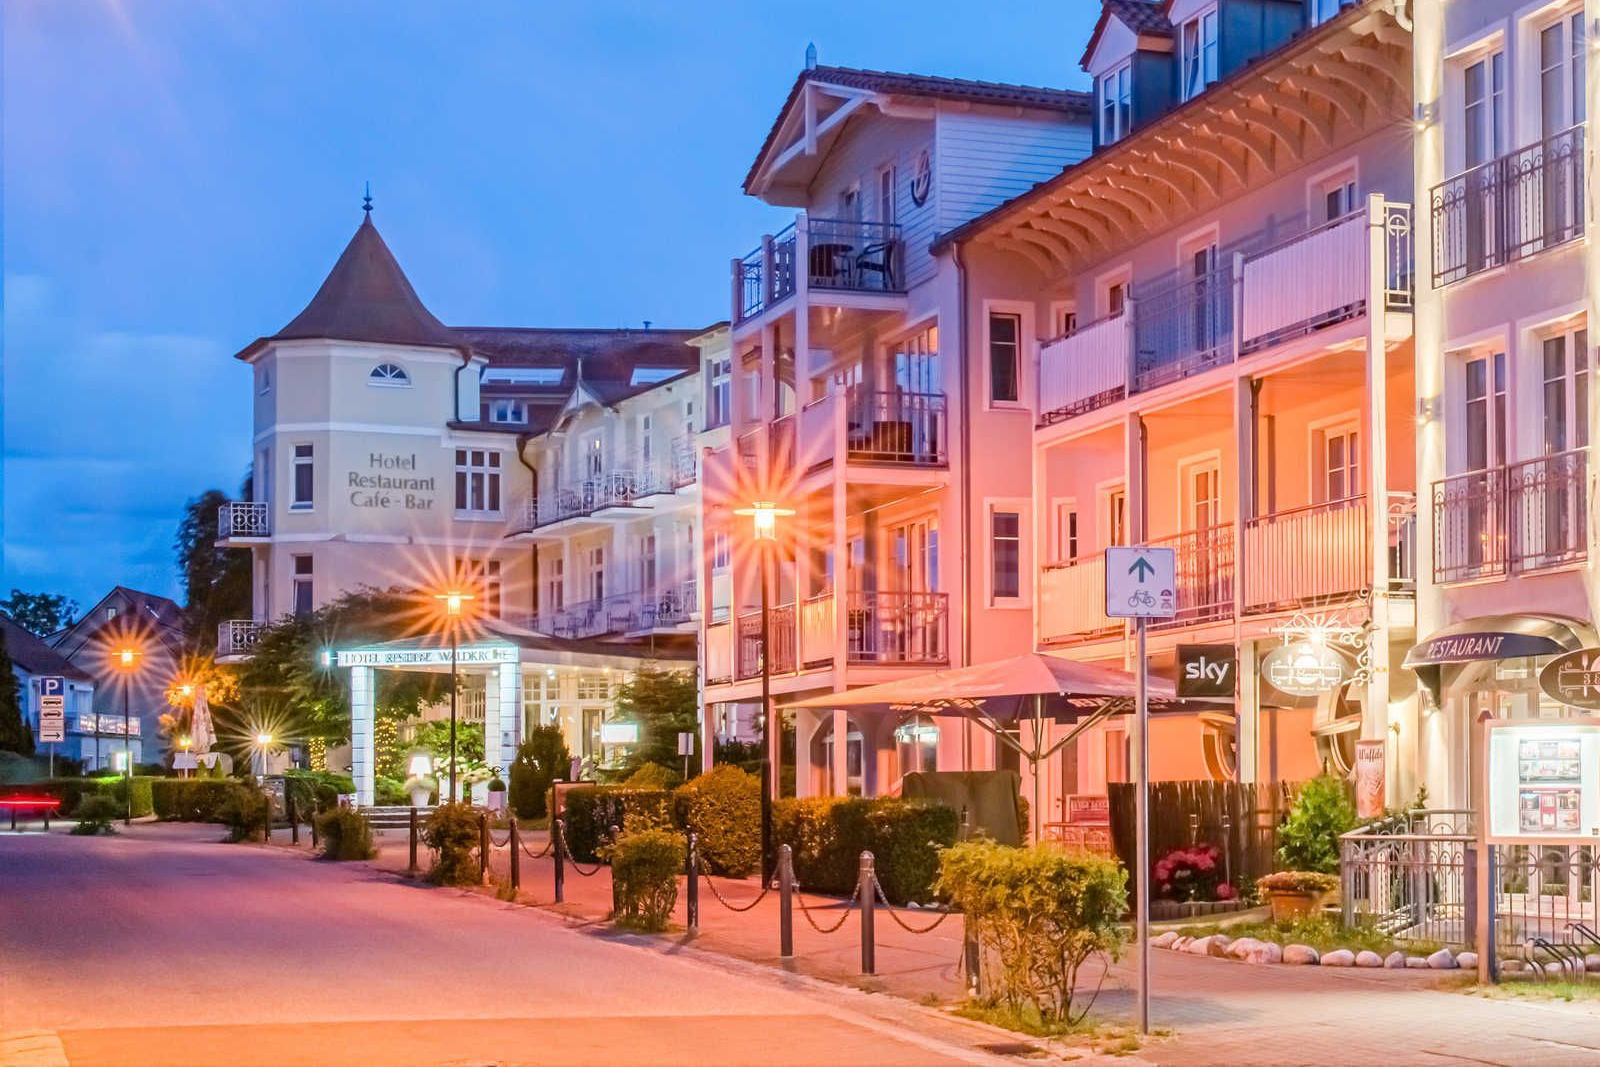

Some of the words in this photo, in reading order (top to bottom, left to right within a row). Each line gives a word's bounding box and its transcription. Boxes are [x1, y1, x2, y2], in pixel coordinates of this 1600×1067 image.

[369, 453, 416, 470] Hotel
[348, 471, 435, 491] Restaurant
[350, 491, 391, 508] Café
[404, 493, 434, 510] Bar
[1427, 635, 1505, 660] RESTAURANT
[345, 652, 381, 665] HOTEL
[1186, 656, 1230, 685] sky
[45, 679, 59, 695] P
